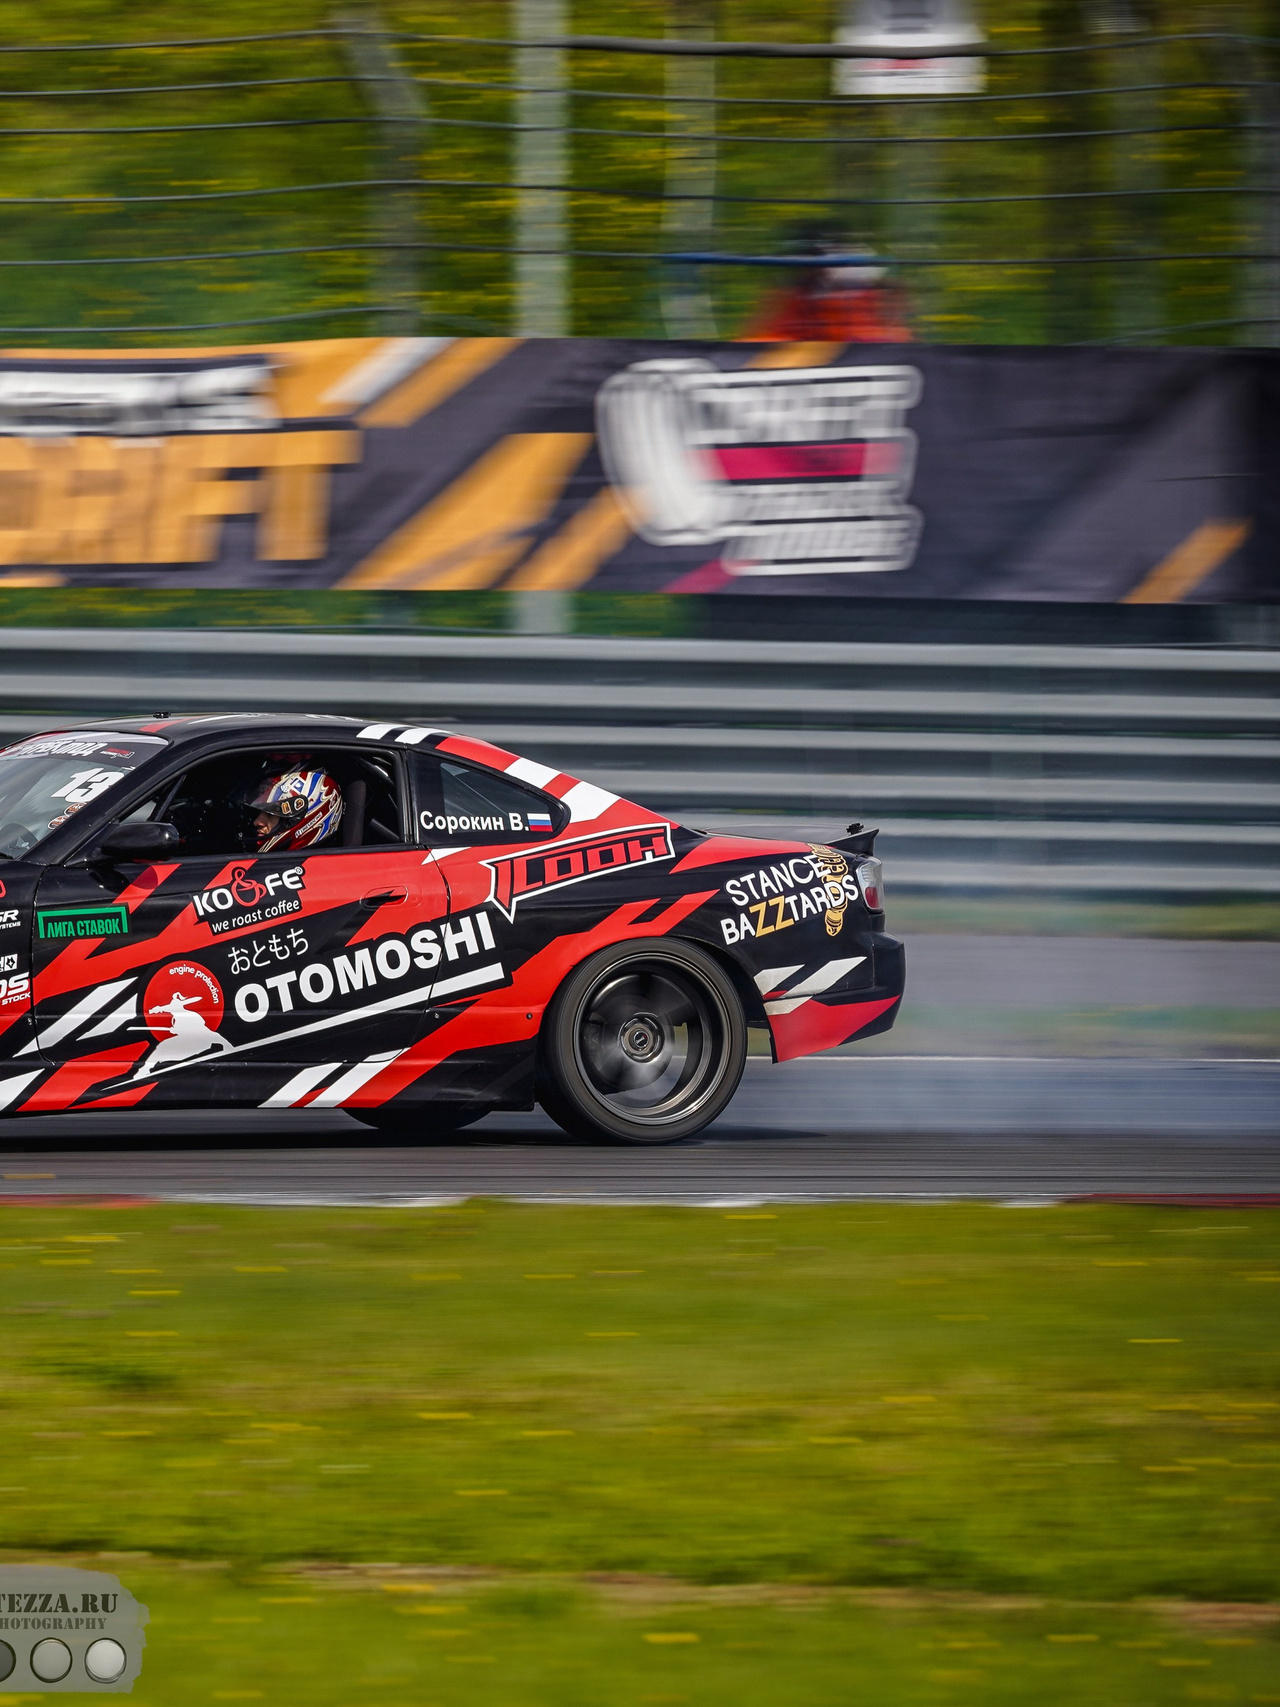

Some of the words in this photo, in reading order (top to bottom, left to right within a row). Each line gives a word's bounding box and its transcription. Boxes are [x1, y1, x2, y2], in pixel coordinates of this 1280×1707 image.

[51, 767, 125, 803] 13
[420, 811, 504, 834] Сорокин
[508, 813, 530, 831] В.
[725, 855, 832, 906] STANCE
[47, 921, 75, 938] ЛИГА
[76, 918, 121, 936] СТАВОК
[211, 920, 230, 933] we
[232, 909, 262, 927] roast
[265, 900, 300, 918] coffee
[720, 875, 859, 945] BAZZTARDS
[227, 928, 309, 974] おともち
[234, 911, 496, 1022] OTOMOSHI
[2, 992, 31, 1005] STOCK
[169, 964, 195, 975] engine
[194, 970, 219, 1004] protection
